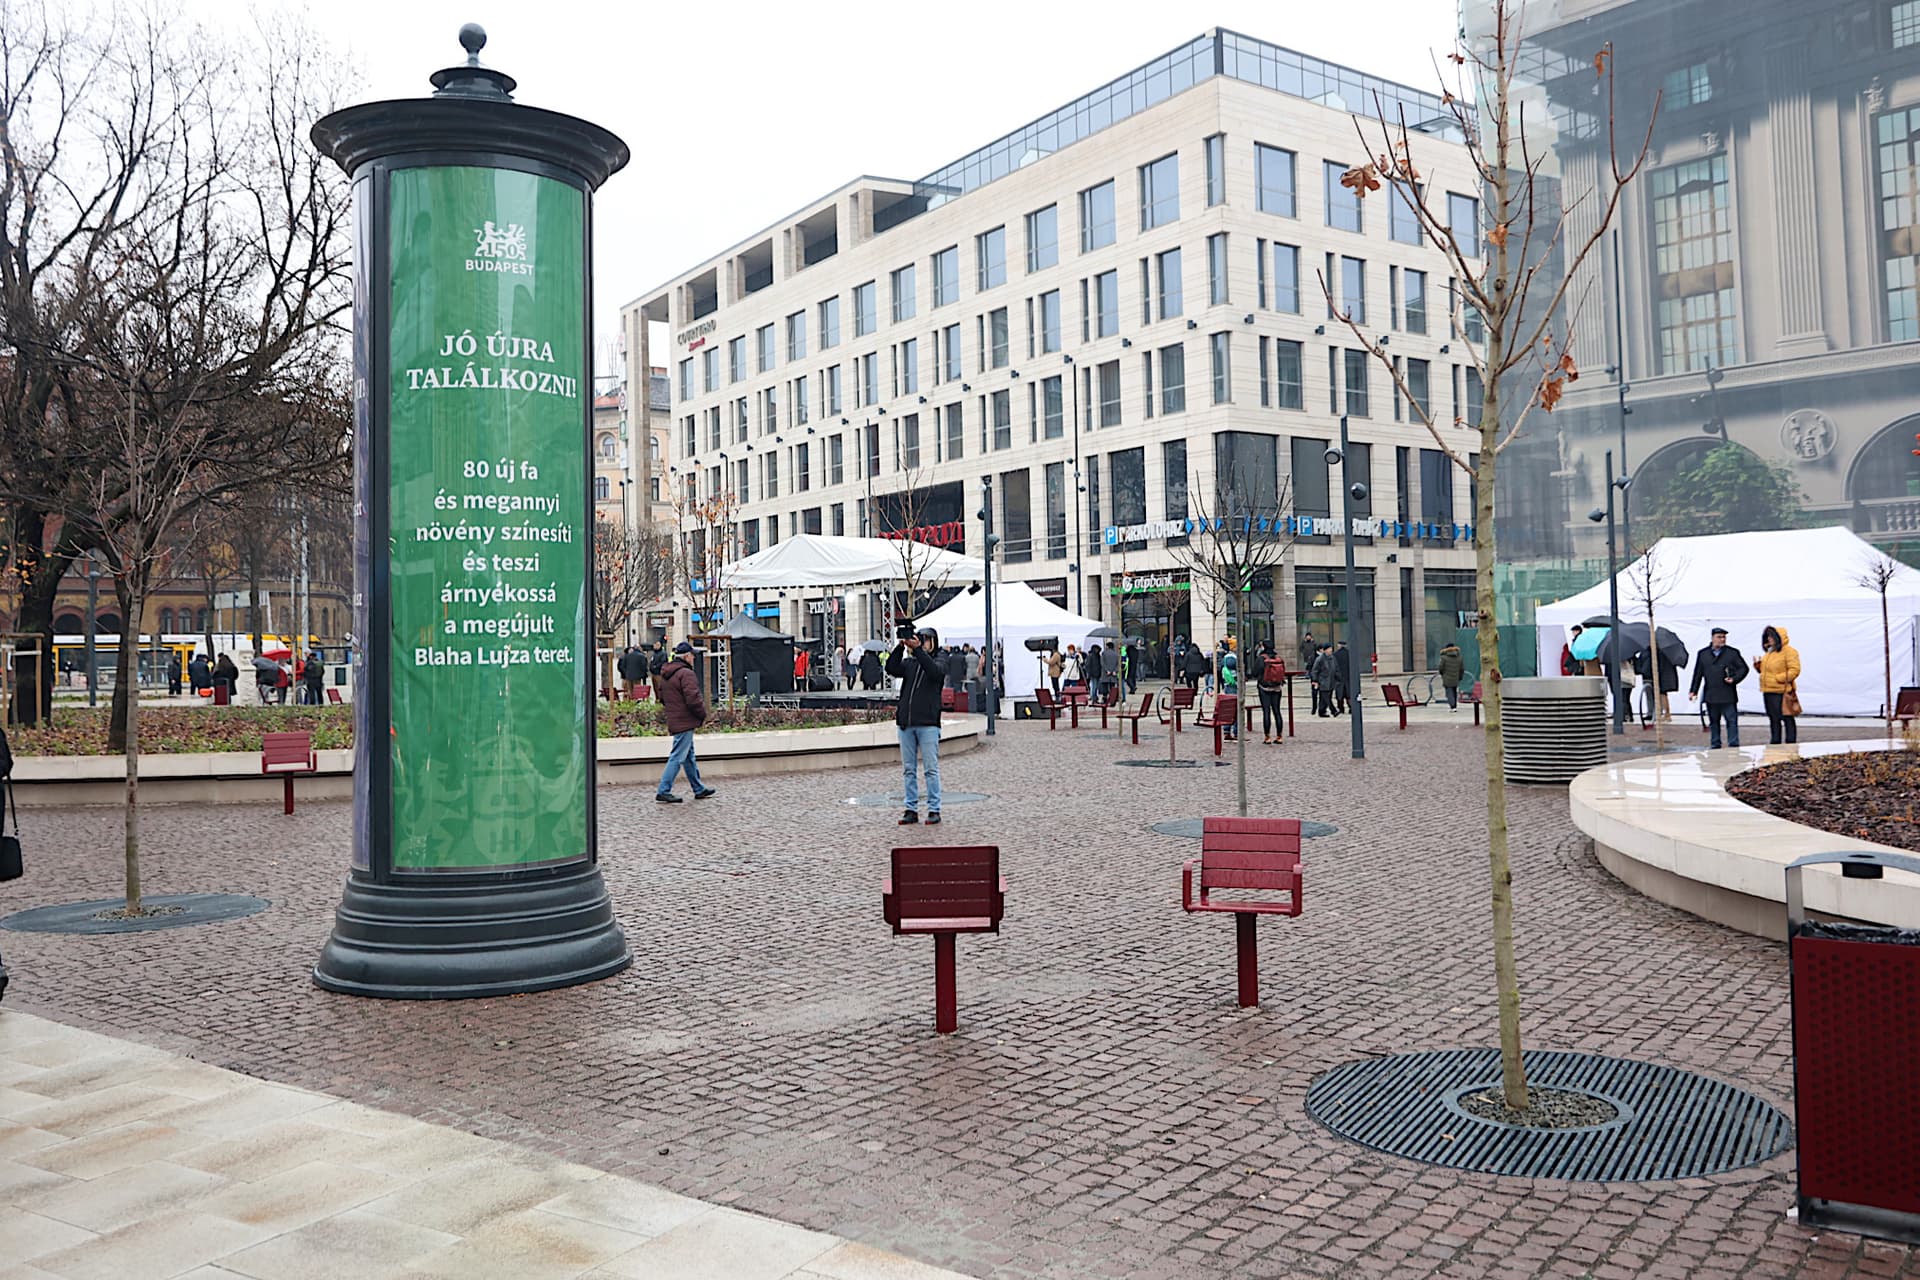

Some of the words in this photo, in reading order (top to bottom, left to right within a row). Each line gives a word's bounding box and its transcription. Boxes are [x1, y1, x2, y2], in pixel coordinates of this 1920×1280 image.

[465, 259, 534, 276] BUDAPEST
[440, 329, 477, 356] JÓ
[486, 330, 555, 363] ÚJRA
[406, 361, 577, 398] TALÁLKOZNI!
[463, 460, 490, 478] 80
[495, 457, 516, 483] új
[520, 461, 538, 480] fa
[434, 488, 458, 509] és
[463, 493, 560, 516] megannyi
[416, 518, 496, 544] növény
[501, 519, 572, 543] színesíti
[463, 550, 487, 571] és
[491, 553, 540, 572] teszi
[441, 581, 556, 607] árnyékossá
[444, 620, 457, 634] a
[463, 612, 555, 638] megújult
[415, 646, 472, 666] Blaha
[478, 645, 530, 669] Lujza
[533, 646, 574, 665] teret.
